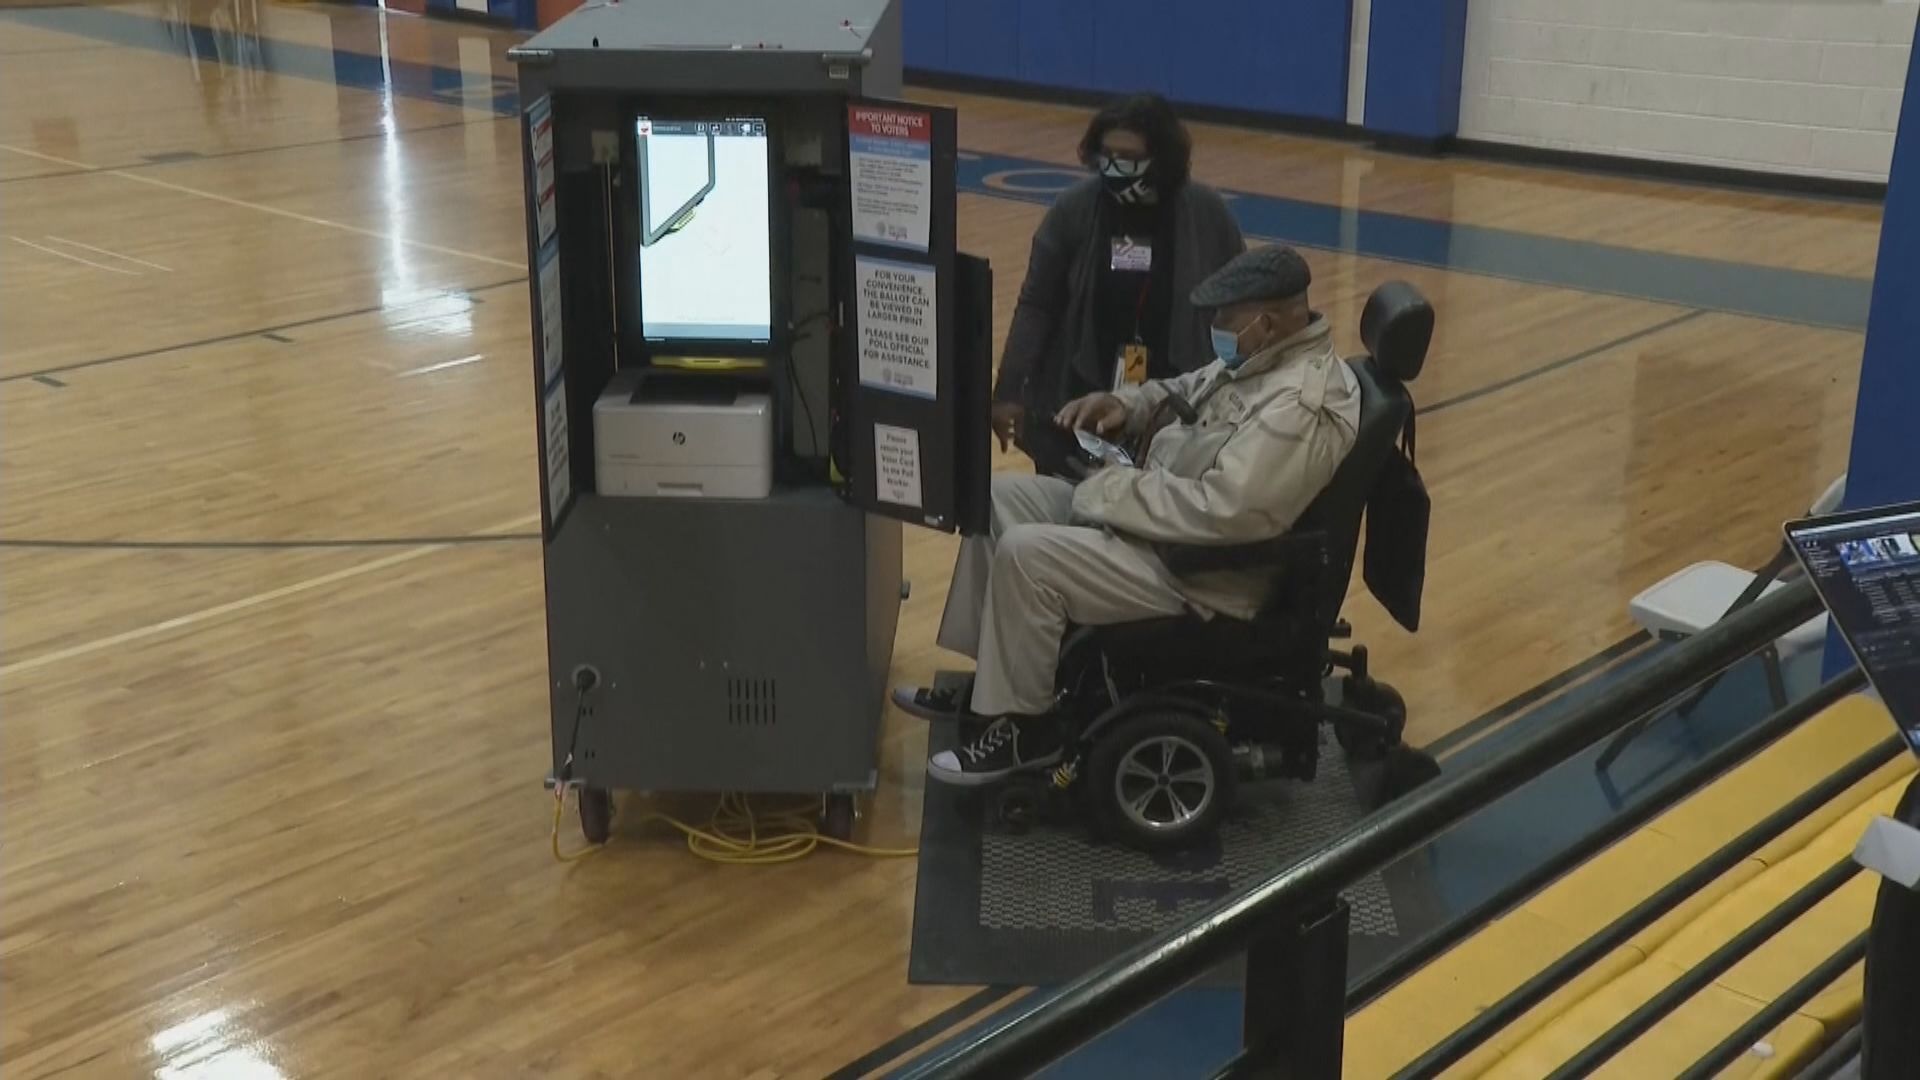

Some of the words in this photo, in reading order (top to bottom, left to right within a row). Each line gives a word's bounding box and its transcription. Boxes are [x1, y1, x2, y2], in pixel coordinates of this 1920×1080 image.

[855, 111, 896, 124] IMPORTANT
[897, 115, 923, 127] NOTICE
[871, 123, 881, 133] TO
[882, 124, 909, 137] VOTERS
[875, 270, 891, 280] FOR
[893, 273, 916, 284] YOUR
[864, 288, 877, 299] THE
[879, 291, 910, 303] BALLOT
[912, 296, 929, 307] CAN
[870, 300, 879, 309] BE
[881, 302, 912, 314] VIEWED
[914, 307, 922, 316] IN
[867, 310, 898, 322] LARGER
[899, 315, 923, 326] PRINT
[865, 328, 893, 340] PLEASE
[895, 332, 910, 343] SEE
[911, 336, 929, 346] OUR
[864, 349, 879, 359] FOR
[869, 338, 888, 349] POLL
[890, 342, 925, 355] OFFICIAL
